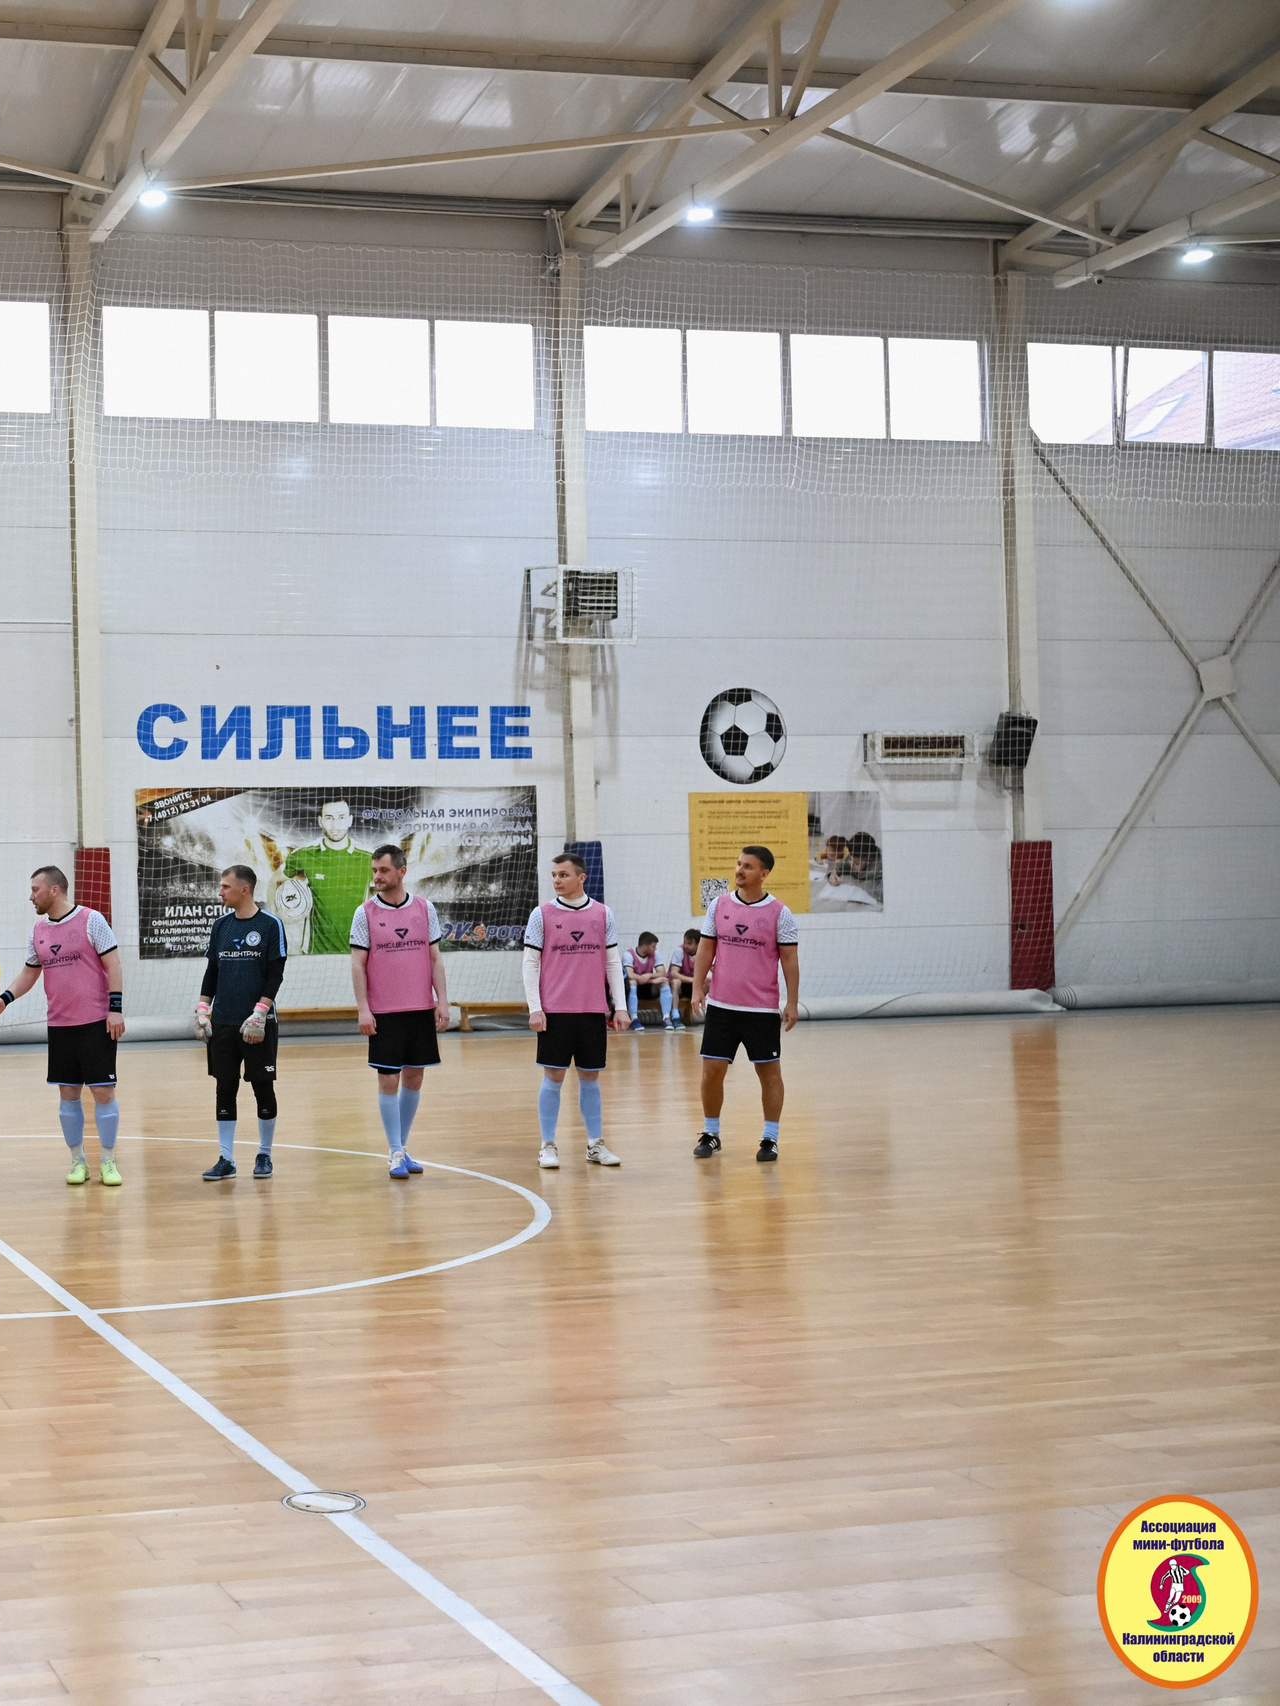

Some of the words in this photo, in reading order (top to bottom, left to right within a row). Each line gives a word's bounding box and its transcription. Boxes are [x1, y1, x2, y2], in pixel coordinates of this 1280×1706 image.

[136, 703, 533, 761] СИЛЬНЕЕ
[154, 791, 193, 809] ЗВОНИТЕ:
[179, 802, 190, 811] 93
[190, 798, 200, 808] 31
[201, 795, 212, 804] 04
[362, 808, 445, 819] ФУТБОЛЬНАЯ
[449, 806, 533, 818] ЭКИПИРОВКА
[394, 822, 477, 832] СПОРТИВНАЯ
[164, 905, 202, 918] ИЛАН
[152, 918, 207, 927] ОФИЦИАЛЬНЫЙ
